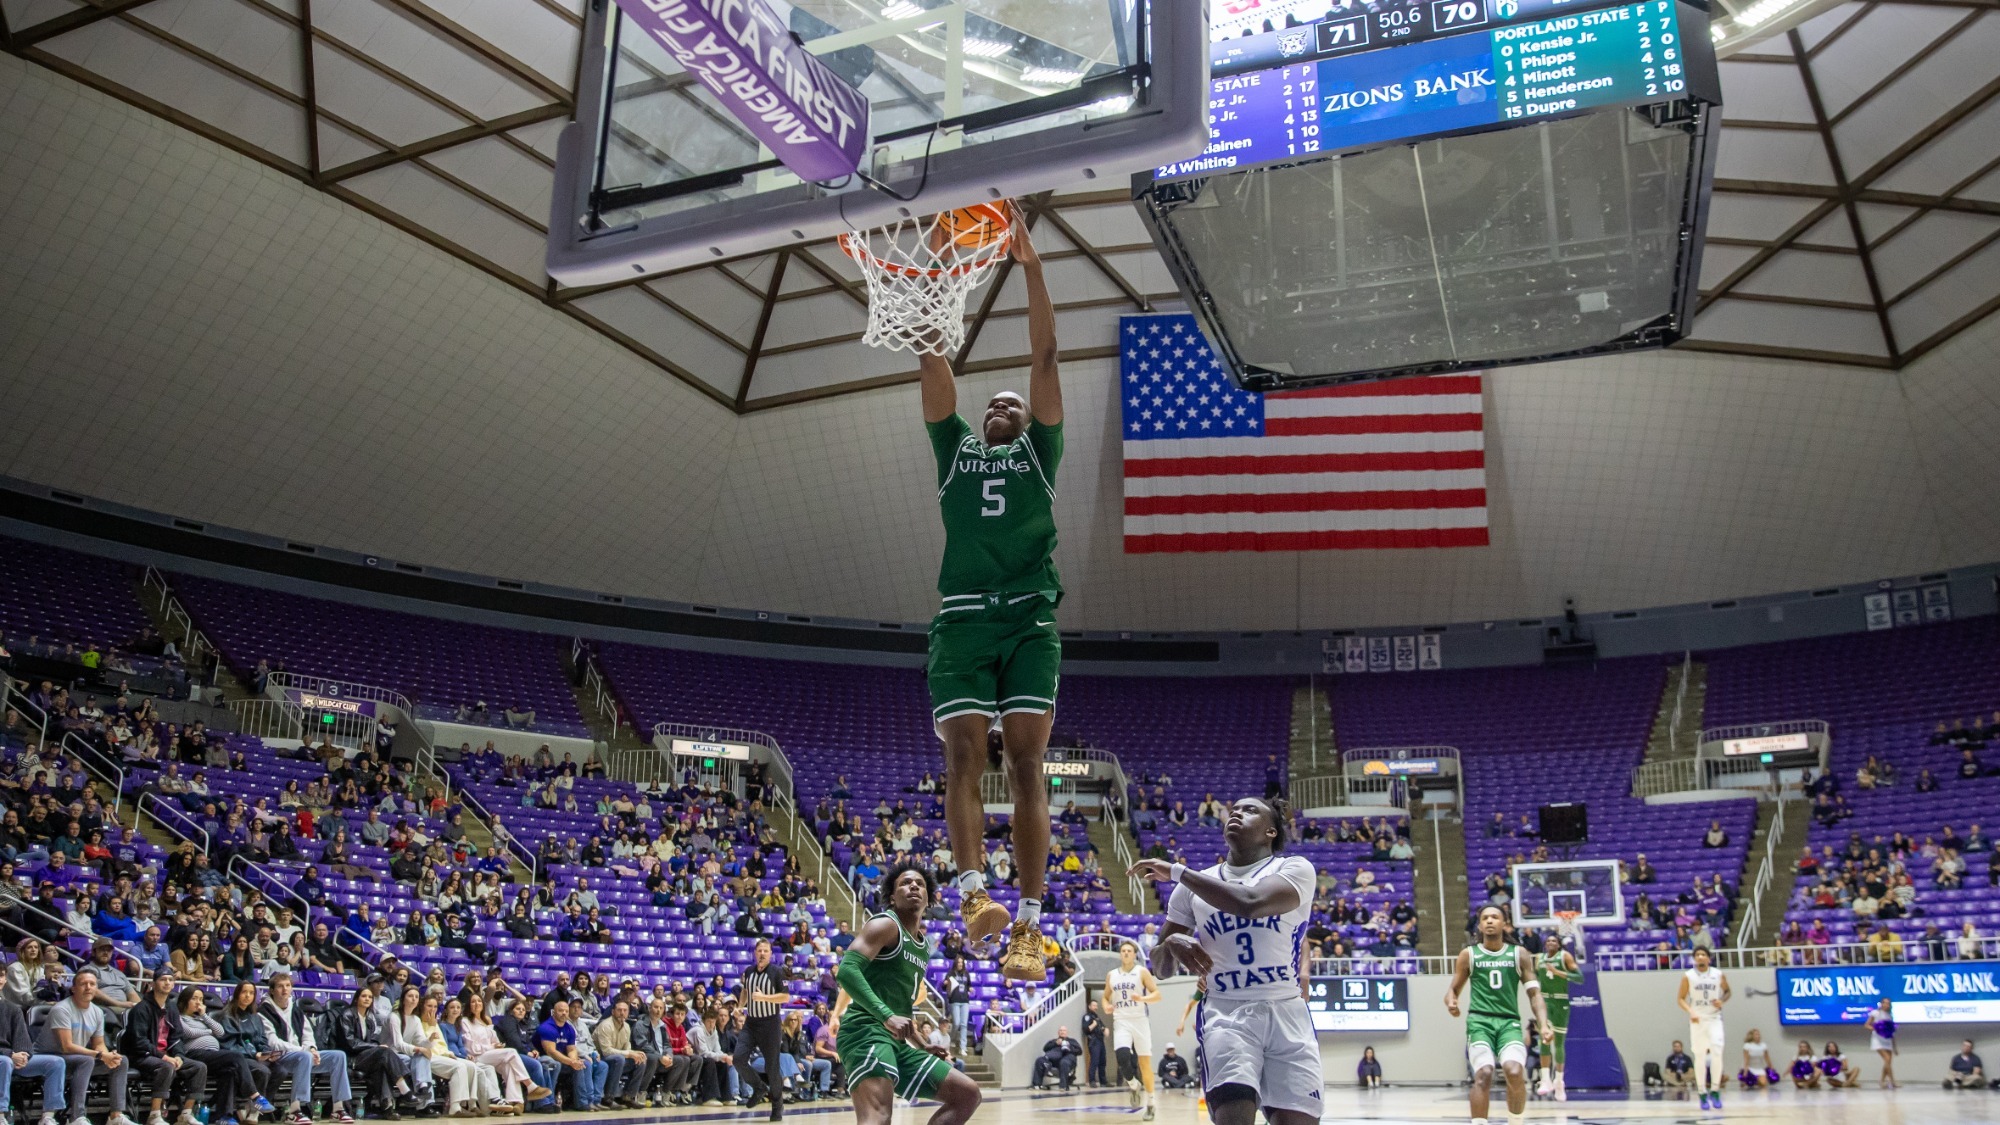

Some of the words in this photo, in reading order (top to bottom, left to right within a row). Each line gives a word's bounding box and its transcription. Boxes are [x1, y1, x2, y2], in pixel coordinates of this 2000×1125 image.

[1379, 10, 1421, 28] 50.6
[1442, 2, 1477, 24] 70
[1495, 17, 1579, 42] PORTLAND
[1582, 8, 1630, 27] STATE
[1636, 5, 1646, 17] F
[1658, 1, 1668, 13] P
[1329, 24, 1356, 45] 71
[1391, 27, 1411, 37] 2ND
[1501, 45, 1513, 57] 0
[1519, 35, 1573, 54] Kensie
[1577, 31, 1597, 45] Jr.
[1638, 22, 1649, 33] 2
[1660, 18, 1671, 30] 7
[1505, 60, 1513, 72] 1
[1521, 50, 1576, 70] Phipps
[1640, 37, 1651, 49] 2
[1661, 33, 1674, 45] 0
[702, 0, 762, 67] ICA
[768, 45, 855, 148] FIRST
[1214, 75, 1261, 93] STATE
[1283, 69, 1291, 80] F
[1302, 66, 1311, 77] P
[1504, 75, 1516, 87] 4
[1523, 65, 1576, 85] Minott
[1641, 52, 1653, 64] 4
[1664, 49, 1675, 61] 6
[693, 31, 818, 145] AMERICA
[1229, 95, 1247, 106] Jr.
[1283, 85, 1292, 96] 2
[1300, 80, 1315, 92] 17
[1507, 91, 1517, 103] 5
[1524, 75, 1613, 100] Henderson
[1644, 68, 1655, 80] 2
[1662, 64, 1680, 77] 18
[1220, 111, 1238, 122] Jr.
[1285, 99, 1293, 110] 1
[1302, 96, 1315, 107] 11
[1324, 84, 1402, 113] ZIONS
[1505, 106, 1523, 119] 15
[1526, 98, 1576, 117] Dupre
[1646, 84, 1657, 96] 2
[1664, 79, 1684, 93] 10
[1284, 114, 1295, 125] 4
[1301, 111, 1317, 122] 13
[1287, 129, 1294, 140] 1
[1302, 125, 1319, 137] 10
[1158, 165, 1177, 177] 24
[1179, 154, 1237, 175] Whiting
[1288, 144, 1295, 155] 1
[1303, 140, 1319, 153] 12
[958, 459, 1031, 474] VIKINGS
[981, 478, 1006, 517] 5
[318, 699, 342, 709] WILDCAT
[707, 732, 716, 742] 4
[1054, 752, 1062, 761] 5
[1235, 932, 1255, 965] 3
[1475, 960, 1514, 968] VIKINGS
[911, 971, 918, 1000] 1
[1214, 965, 1290, 992] STATE
[1489, 969, 1503, 989] 0
[1790, 976, 1833, 997] ZIONS
[1902, 974, 1949, 994] ZIONS
